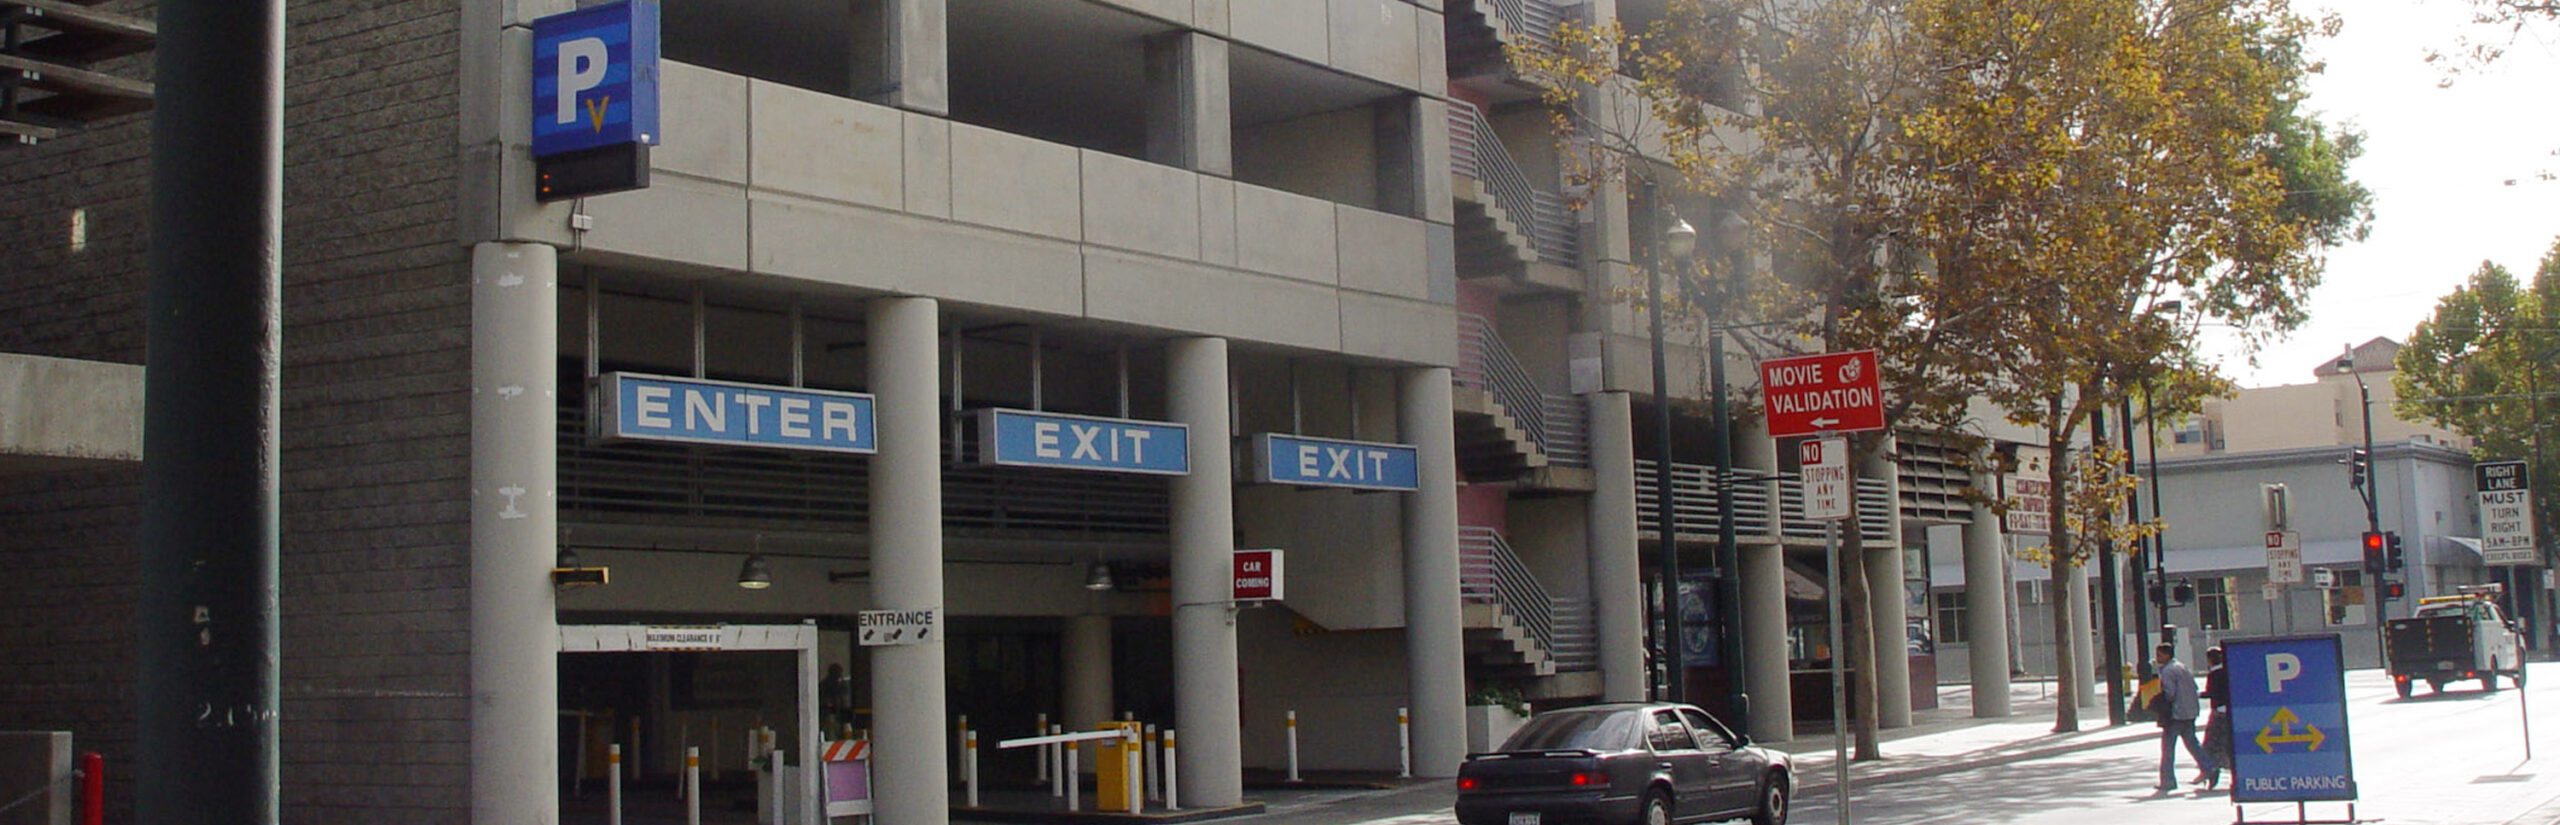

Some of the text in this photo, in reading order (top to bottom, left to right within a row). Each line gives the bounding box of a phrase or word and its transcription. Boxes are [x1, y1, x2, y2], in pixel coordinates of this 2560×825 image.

[558, 37, 608, 125] P
[1769, 364, 1823, 387] MOVIE
[1772, 387, 1874, 415] VALIDATION
[637, 385, 857, 442] ENTER
[1035, 421, 1151, 464] EXIT
[1803, 444, 1820, 462] NO
[1298, 445, 1389, 481] EXIT
[1805, 466, 1845, 484] STOPPING
[2485, 465, 2516, 478] RIGHT
[1816, 484, 1834, 496] ANY
[2487, 477, 2516, 490] LANE
[1817, 498, 1836, 510] TIME
[2482, 492, 2524, 505] MUST
[2491, 507, 2519, 519] TURN
[2491, 521, 2521, 533] RIGHT
[2267, 533, 2280, 546] NO
[1243, 561, 1261, 572] CAR
[1236, 577, 1269, 588] COMING
[859, 611, 933, 626] ENTRANCE
[2265, 653, 2301, 693] P
[2245, 775, 2346, 791] PUBLIC PARKING
